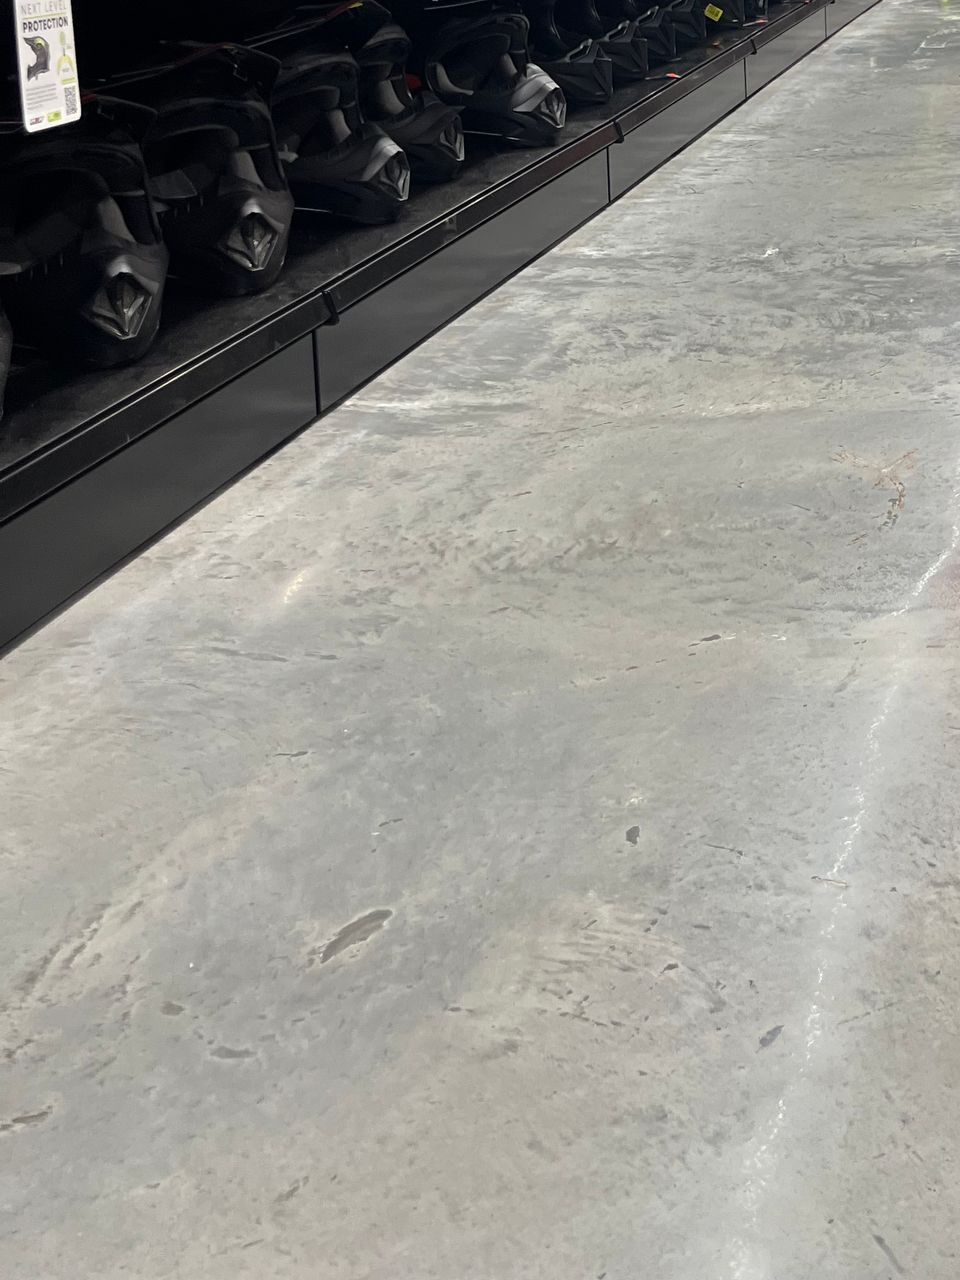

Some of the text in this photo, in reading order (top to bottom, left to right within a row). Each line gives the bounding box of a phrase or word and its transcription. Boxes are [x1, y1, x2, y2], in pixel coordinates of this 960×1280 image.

[21, 0, 67, 15] NEXT LEVEL
[22, 15, 69, 34] PROTECTION
